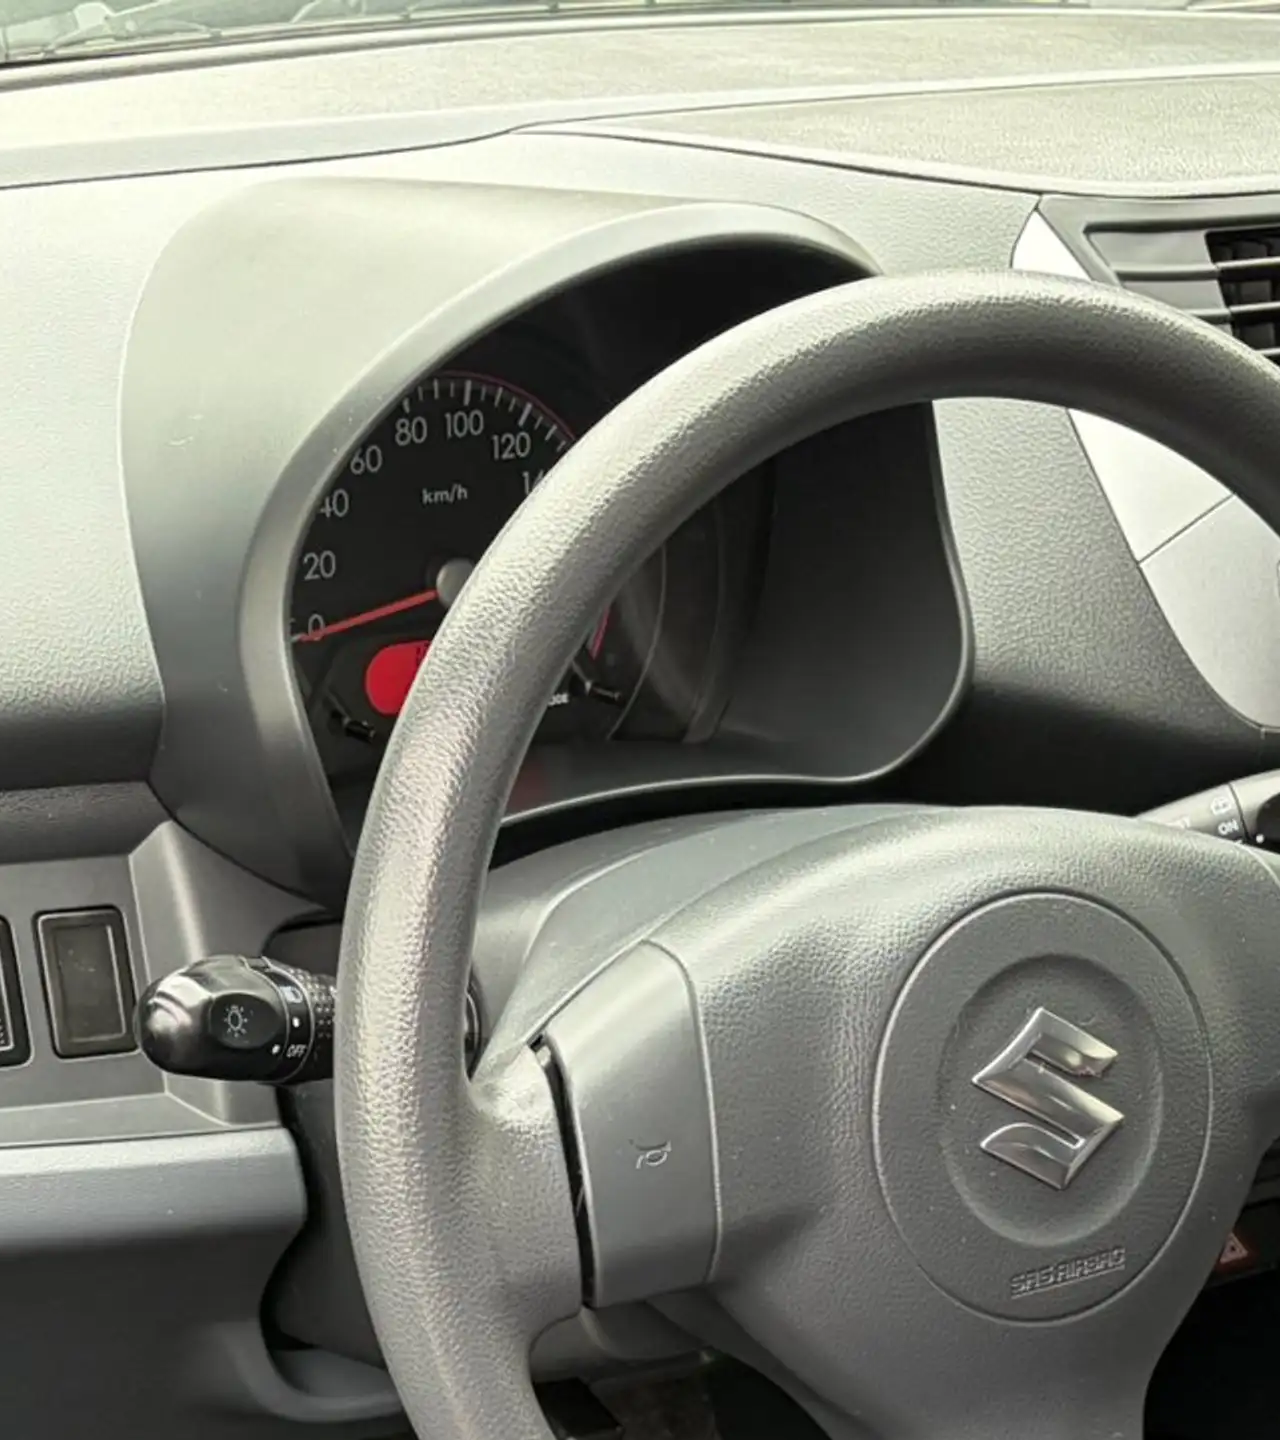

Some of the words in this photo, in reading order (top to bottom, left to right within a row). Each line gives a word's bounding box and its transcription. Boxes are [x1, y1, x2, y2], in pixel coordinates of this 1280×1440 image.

[394, 416, 428, 446] 80
[445, 409, 485, 438] 100
[349, 444, 383, 475] 60
[492, 431, 532, 461] 120
[422, 484, 468, 505] km/h
[303, 550, 337, 581] 20
[1218, 819, 1239, 836] ON
